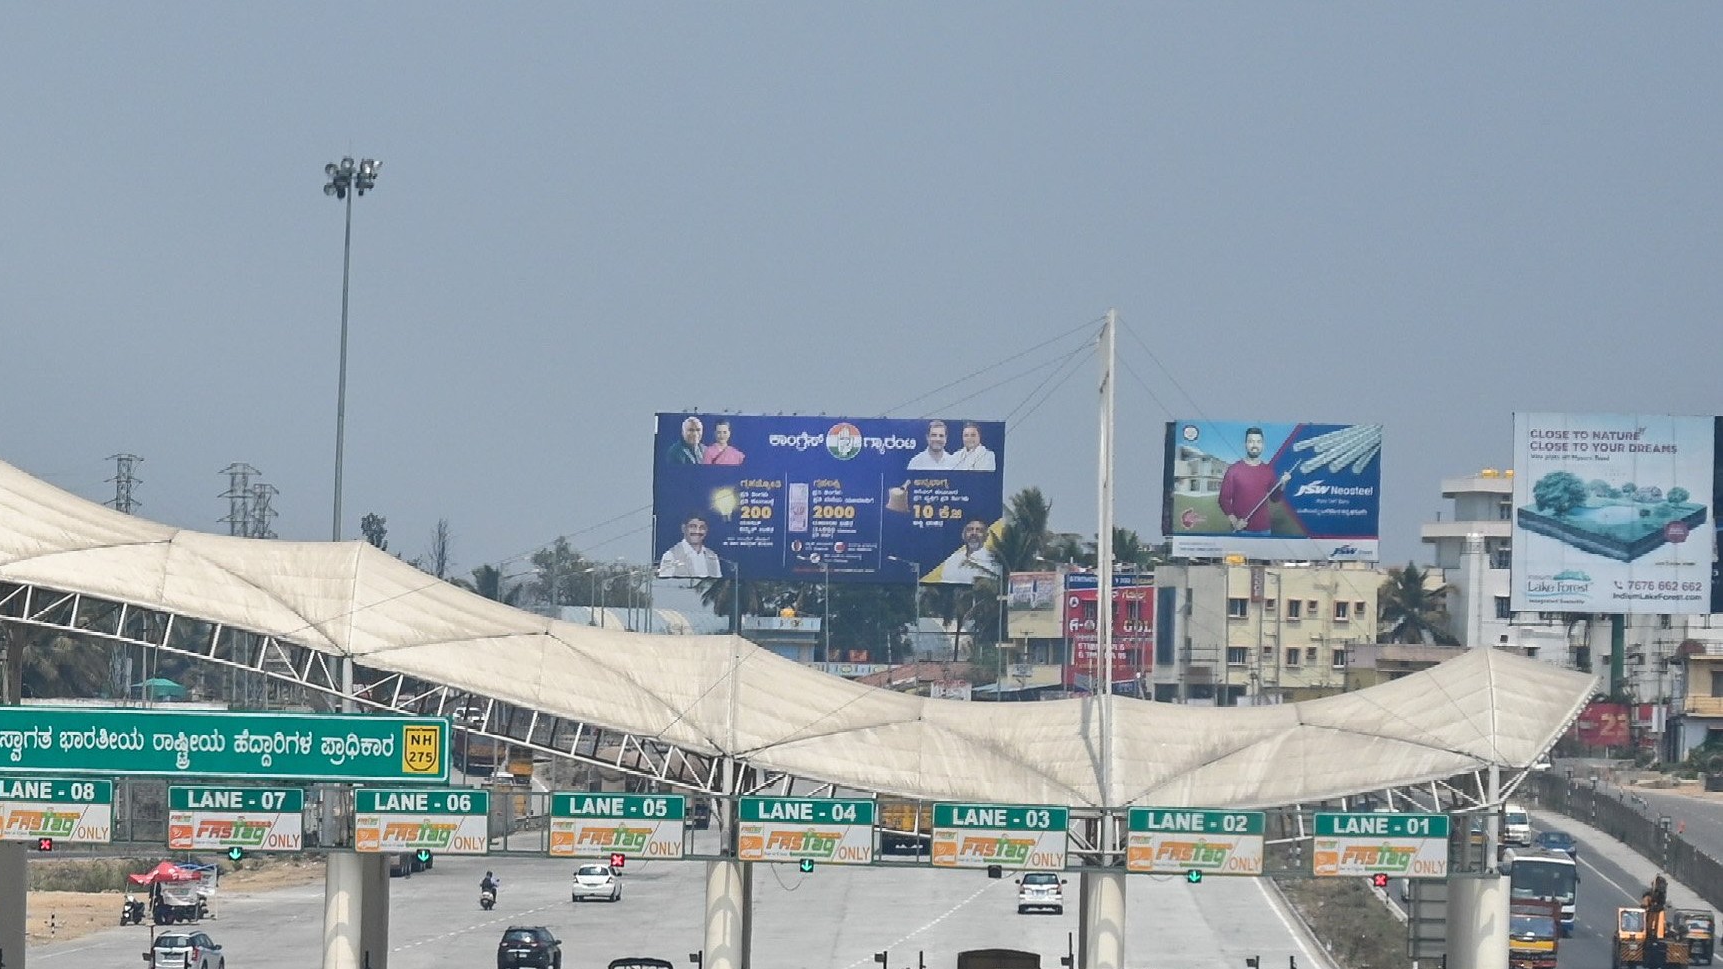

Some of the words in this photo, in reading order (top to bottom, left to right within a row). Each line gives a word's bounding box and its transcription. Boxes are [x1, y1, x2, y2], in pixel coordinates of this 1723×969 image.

[1530, 429, 1569, 439] CLOSE
[1573, 430, 1589, 439] TO
[1530, 441, 1569, 451] CLOSE
[1573, 442, 1589, 451] TO
[1592, 443, 1625, 453] YOUR
[1628, 443, 1678, 454] DREAMS
[1294, 480, 1330, 497] JSW
[1330, 485, 1373, 496] Neosteel
[740, 505, 773, 519] 200
[812, 505, 856, 519] 2000
[912, 504, 934, 519] 10
[1528, 580, 1555, 593] Lake
[1557, 580, 1589, 593] Forest
[1123, 619, 1153, 632] GOL
[59, 725, 145, 753] ಭಾರತೀಯ
[152, 728, 226, 769] ರಾಷ್ಟ್ರೀಯ
[233, 728, 313, 768] ಹೆದ್ದಾರಿಗಳ
[320, 731, 395, 766] ಪ್ರಾಧಿಕಾರ
[410, 734, 432, 746] NH
[409, 751, 433, 763] 275
[70, 782, 95, 800] 08
[187, 790, 243, 808] LANE
[260, 792, 287, 810] 07
[374, 793, 429, 811] LANE
[446, 794, 471, 812] 06
[569, 798, 624, 815] LANE
[642, 799, 667, 817] 05
[758, 801, 813, 819] LANE
[831, 803, 857, 822] 04
[952, 808, 1007, 826] LANE
[1026, 810, 1050, 828] 03
[1148, 813, 1204, 831] LANE
[1223, 814, 1248, 832] 02
[78, 826, 109, 839] ONLY
[1333, 817, 1388, 834] LANE
[1406, 819, 1429, 835] 01
[268, 834, 300, 848] ONLY
[453, 837, 485, 850] ONLY
[649, 841, 681, 855] ONLY
[838, 846, 870, 860] ONLY
[1032, 852, 1063, 867] ONLY
[1229, 857, 1261, 871] ONLY
[1414, 861, 1445, 875] ONLY
